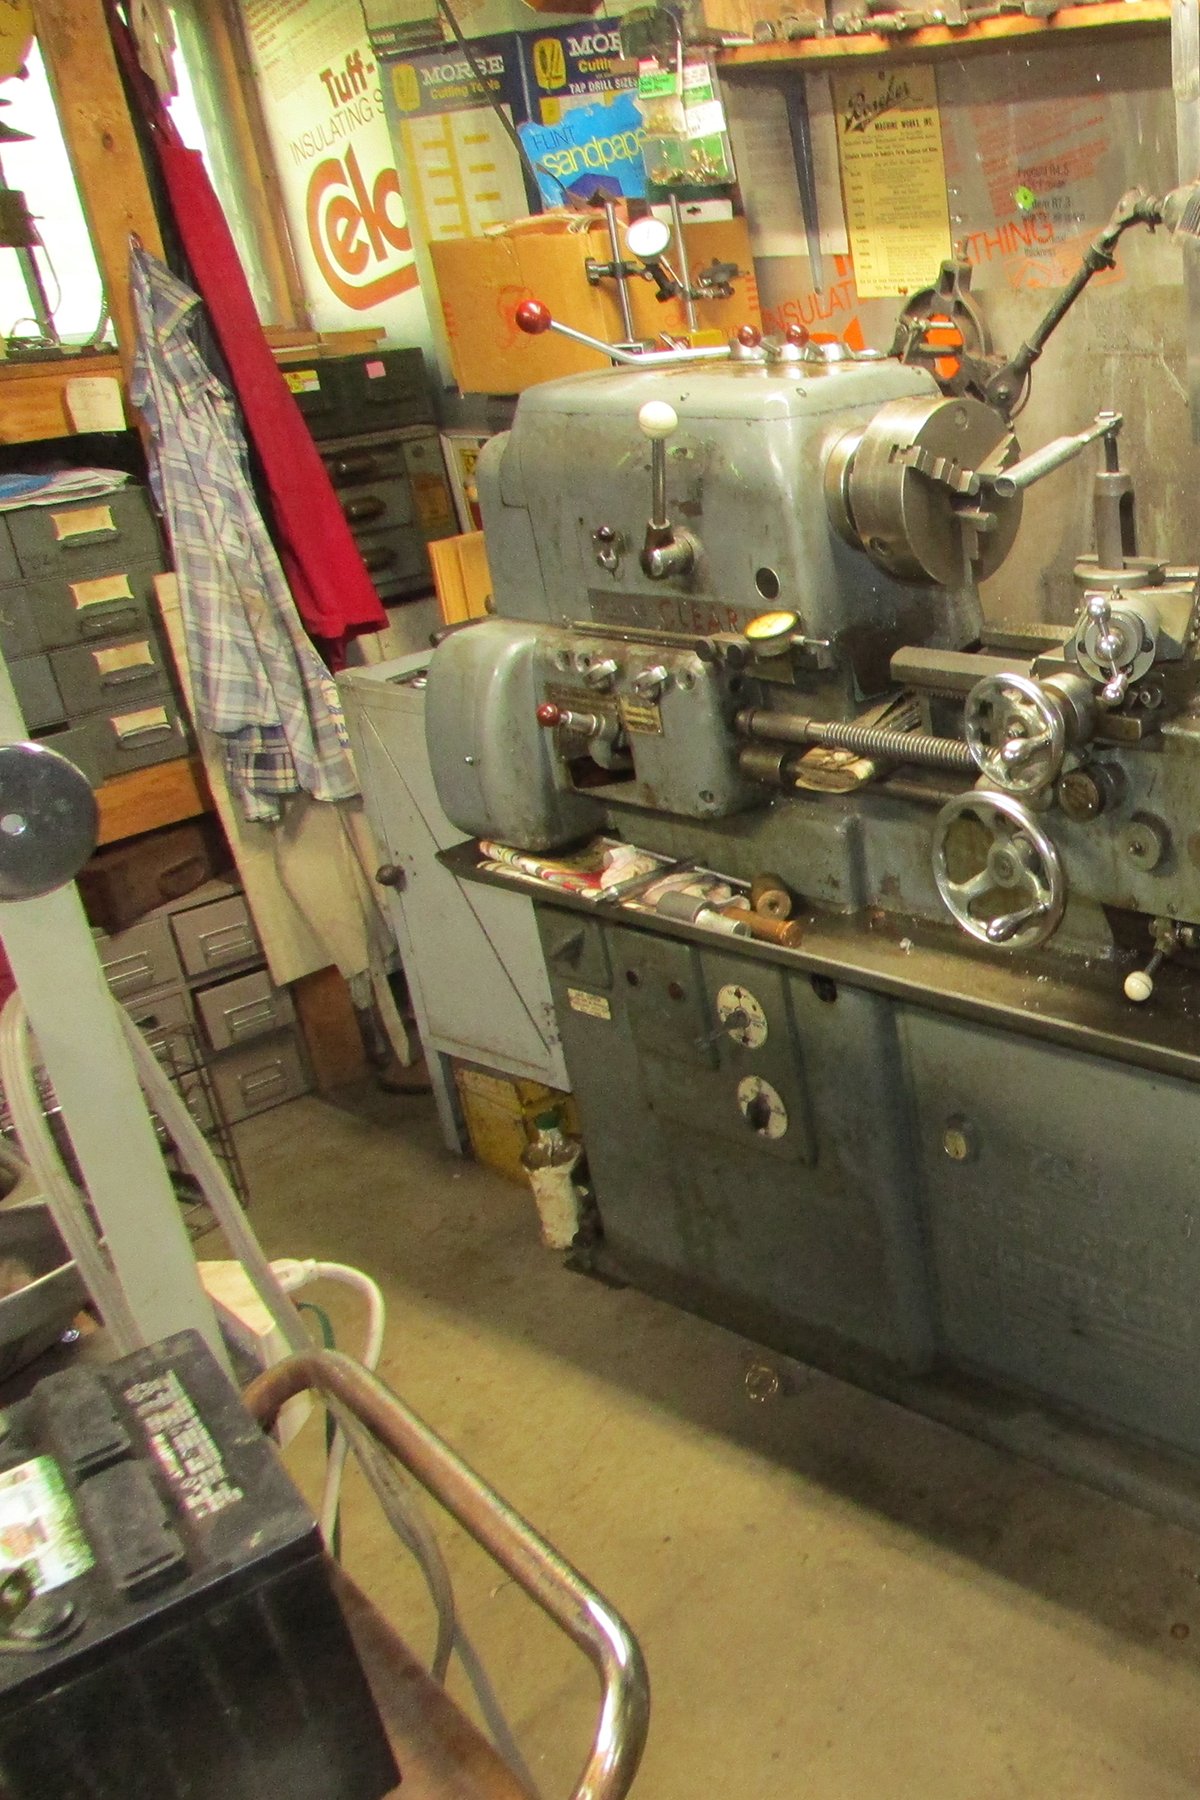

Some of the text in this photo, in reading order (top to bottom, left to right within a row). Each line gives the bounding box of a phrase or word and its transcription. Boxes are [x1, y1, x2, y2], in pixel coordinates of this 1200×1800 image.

[319, 49, 375, 108] Tuff-
[420, 55, 505, 87] MORSE
[569, 83, 587, 94] TAP
[588, 79, 613, 92] DRILL
[431, 86, 469, 100] Cutting
[290, 97, 375, 165] INSULATING
[532, 126, 576, 151] FLINT
[542, 127, 647, 178] sandpap
